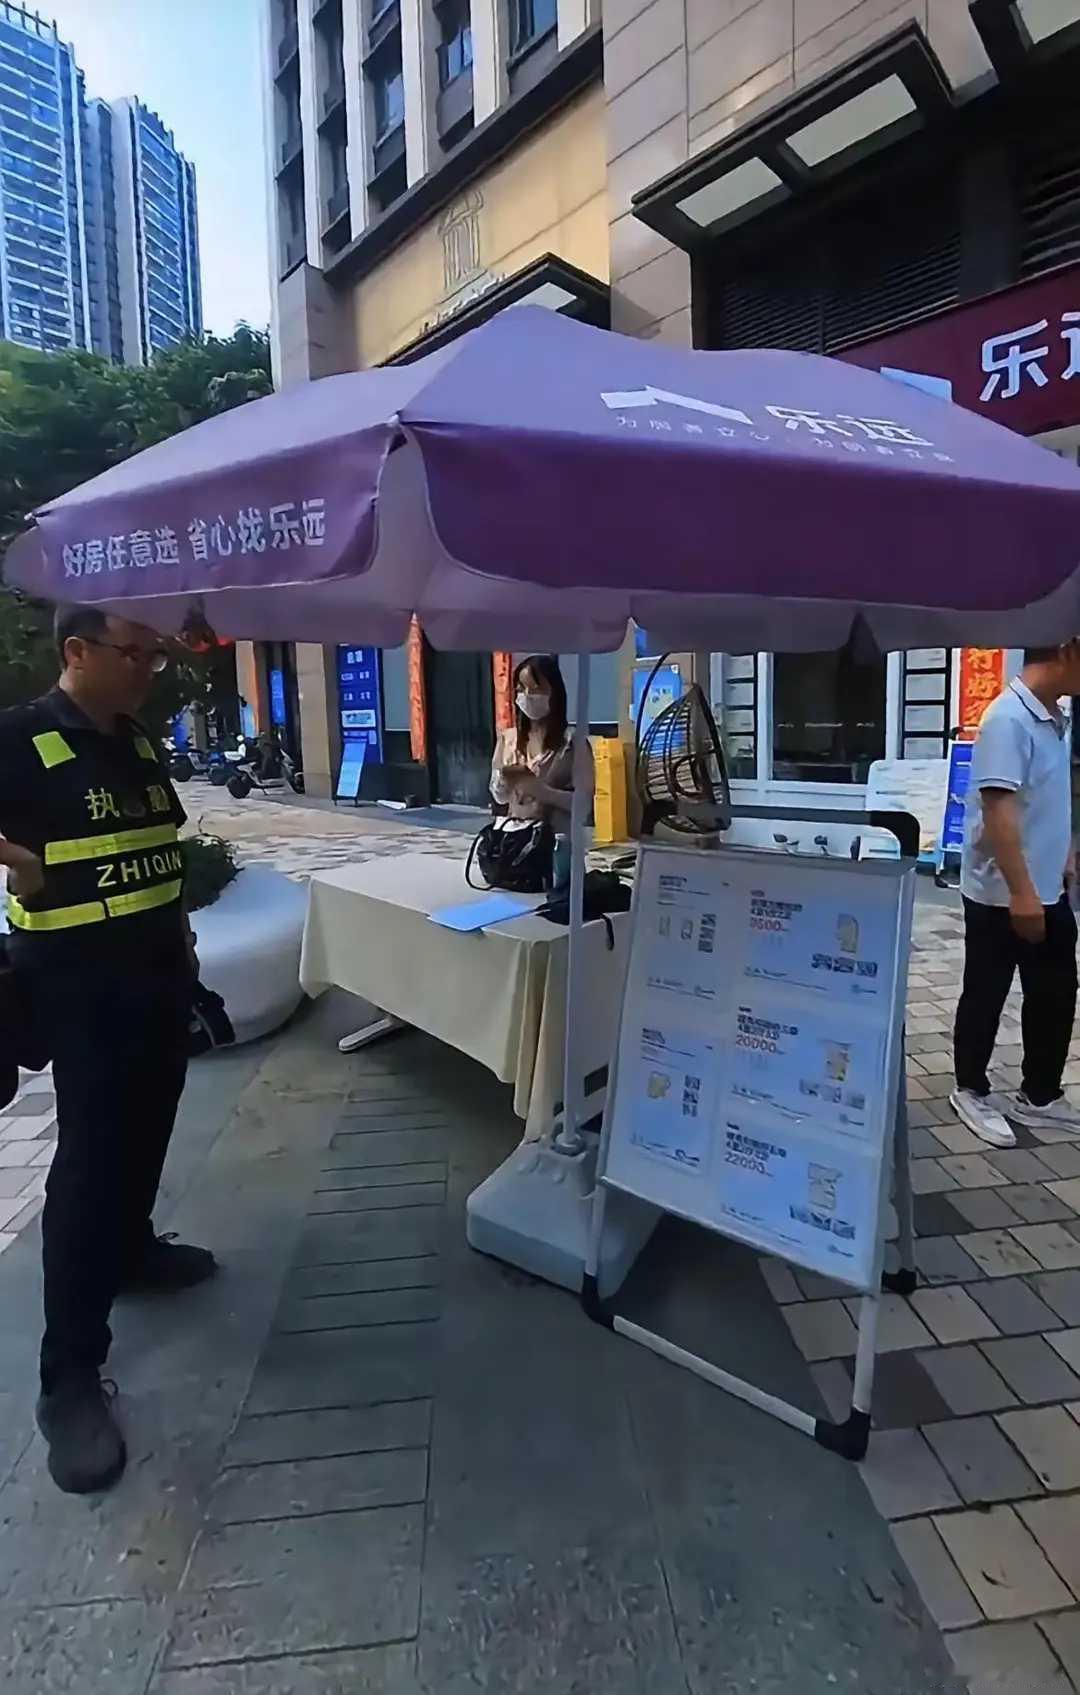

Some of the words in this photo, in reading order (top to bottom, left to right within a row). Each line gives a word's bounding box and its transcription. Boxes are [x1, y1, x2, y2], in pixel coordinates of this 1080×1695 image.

[765, 405, 935, 446] 乐远
[62, 524, 180, 577] 好房任意选
[187, 497, 325, 561] 省心找乐远
